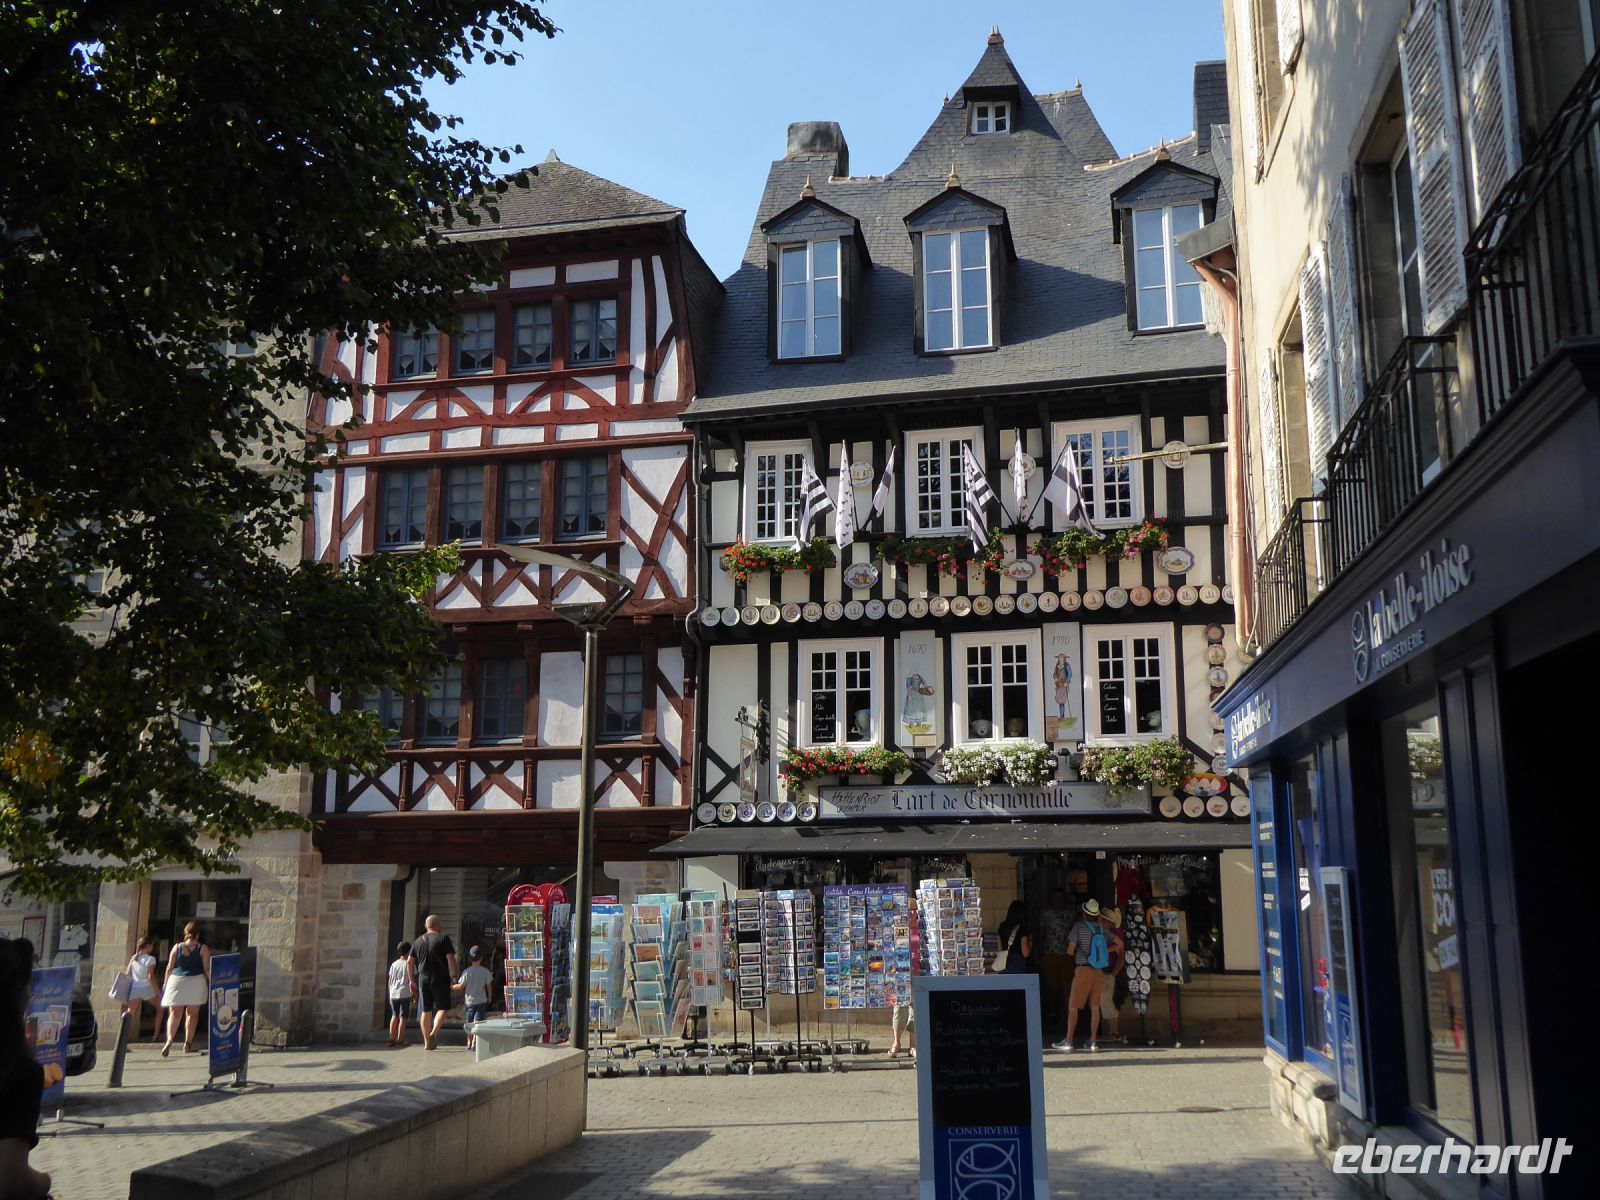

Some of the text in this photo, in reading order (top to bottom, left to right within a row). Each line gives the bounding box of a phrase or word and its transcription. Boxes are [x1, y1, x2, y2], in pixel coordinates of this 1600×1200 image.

[943, 794, 958, 810] de
[964, 788, 1073, 810] Cornouaille
[948, 1126, 1019, 1136] CONSERVERIE
